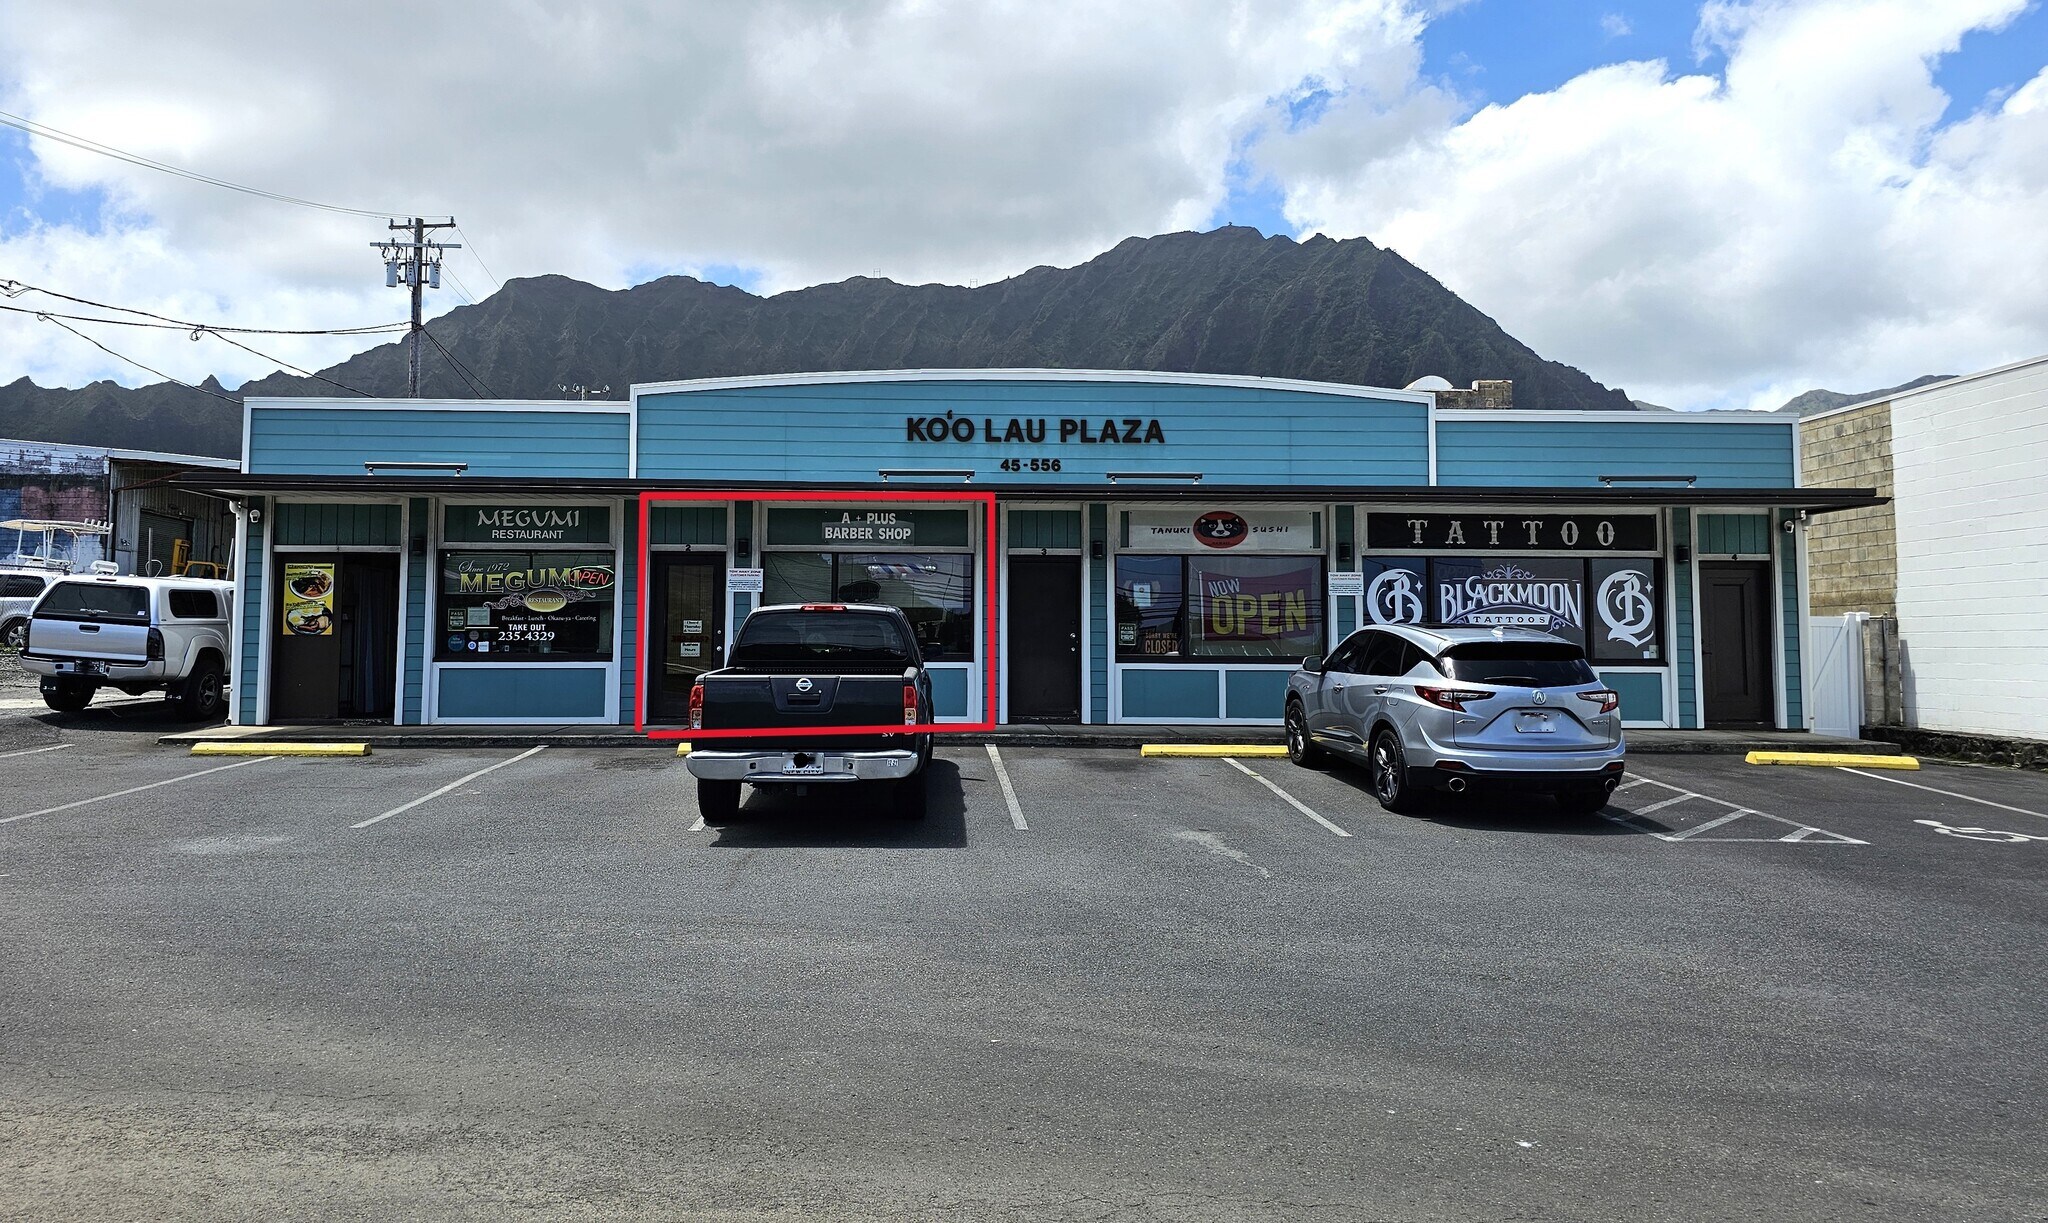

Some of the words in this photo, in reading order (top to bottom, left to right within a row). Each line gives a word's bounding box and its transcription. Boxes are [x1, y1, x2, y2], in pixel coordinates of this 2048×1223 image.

[985, 418, 1046, 443] LAU
[1060, 419, 1165, 444] PLAZA
[1000, 458, 1061, 472] 45-556
[477, 509, 580, 528] MEGUMI
[841, 512, 851, 524] A
[867, 512, 897, 525] PLUS
[491, 529, 564, 540] RESTAURANT
[824, 527, 873, 540] BARBER
[878, 527, 912, 541] SHOP
[1150, 527, 1191, 535] TANUKI
[1407, 518, 1616, 547] TATTOO
[685, 544, 692, 552] 2
[458, 559, 484, 573] Since
[486, 562, 510, 573] 1972
[459, 567, 581, 593] MEGUMI
[570, 570, 610, 586] OPEN
[1208, 577, 1241, 598] NOW
[1440, 575, 1583, 630] BLACKMOON
[1211, 588, 1308, 636] OPEN
[1473, 616, 1546, 624] TATTOOS
[498, 631, 556, 641] 235.4329
[1145, 639, 1178, 654] CLOSED
